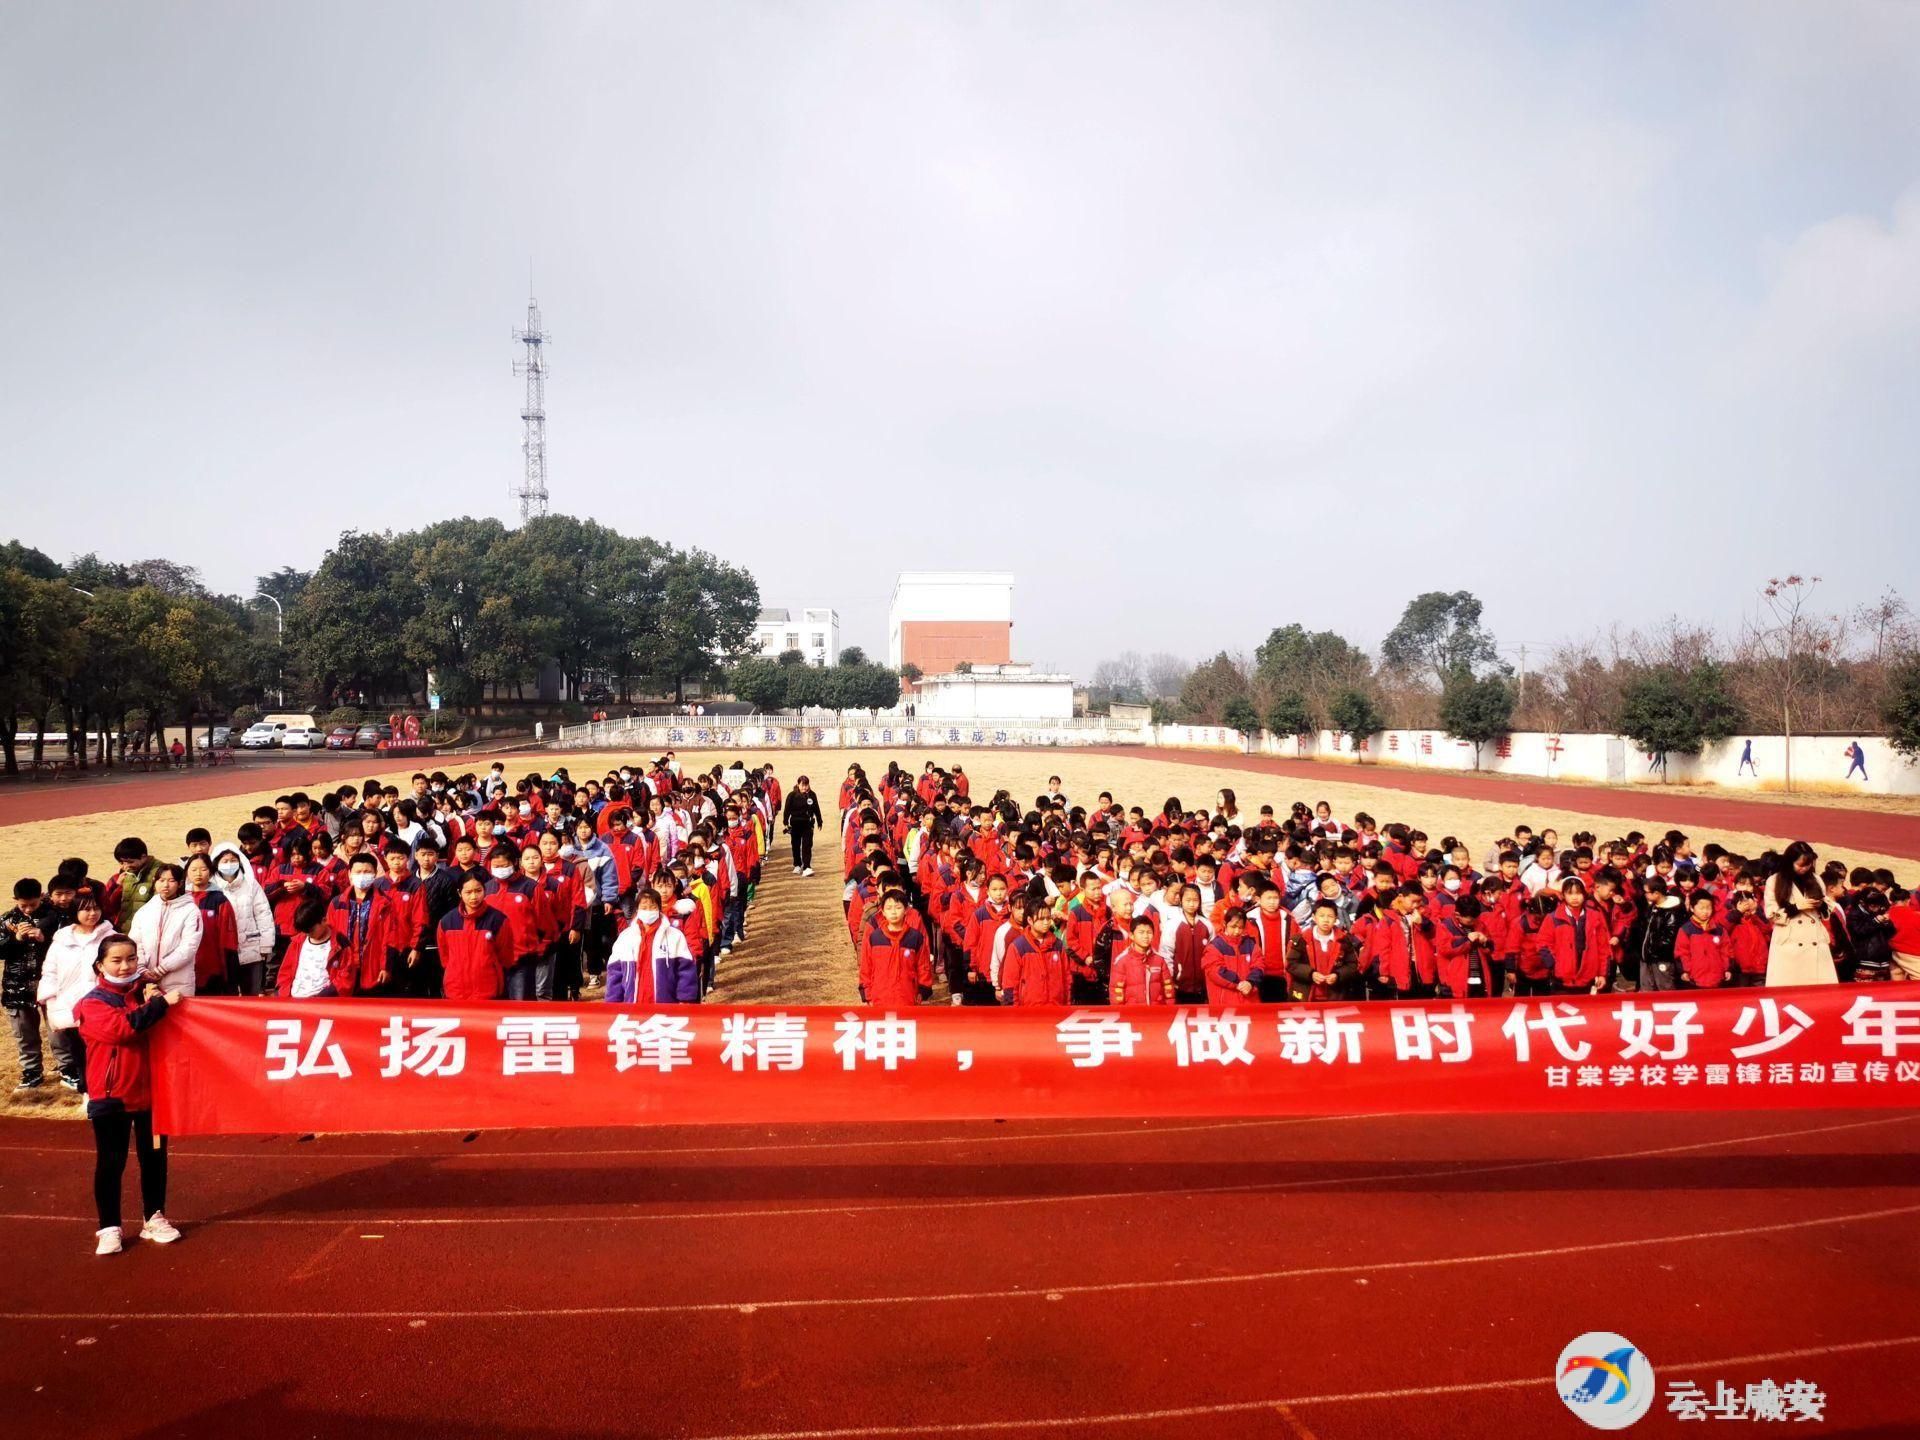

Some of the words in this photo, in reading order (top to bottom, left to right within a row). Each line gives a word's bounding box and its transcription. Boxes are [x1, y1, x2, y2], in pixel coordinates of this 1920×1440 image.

[671, 729, 733, 743] 我努力
[764, 728, 826, 743] 我进步
[858, 729, 917, 743] 我自信
[948, 729, 1008, 743] 我成功
[1545, 1061, 1920, 1088] 甘棠学校学雷锋活动宣传仪
